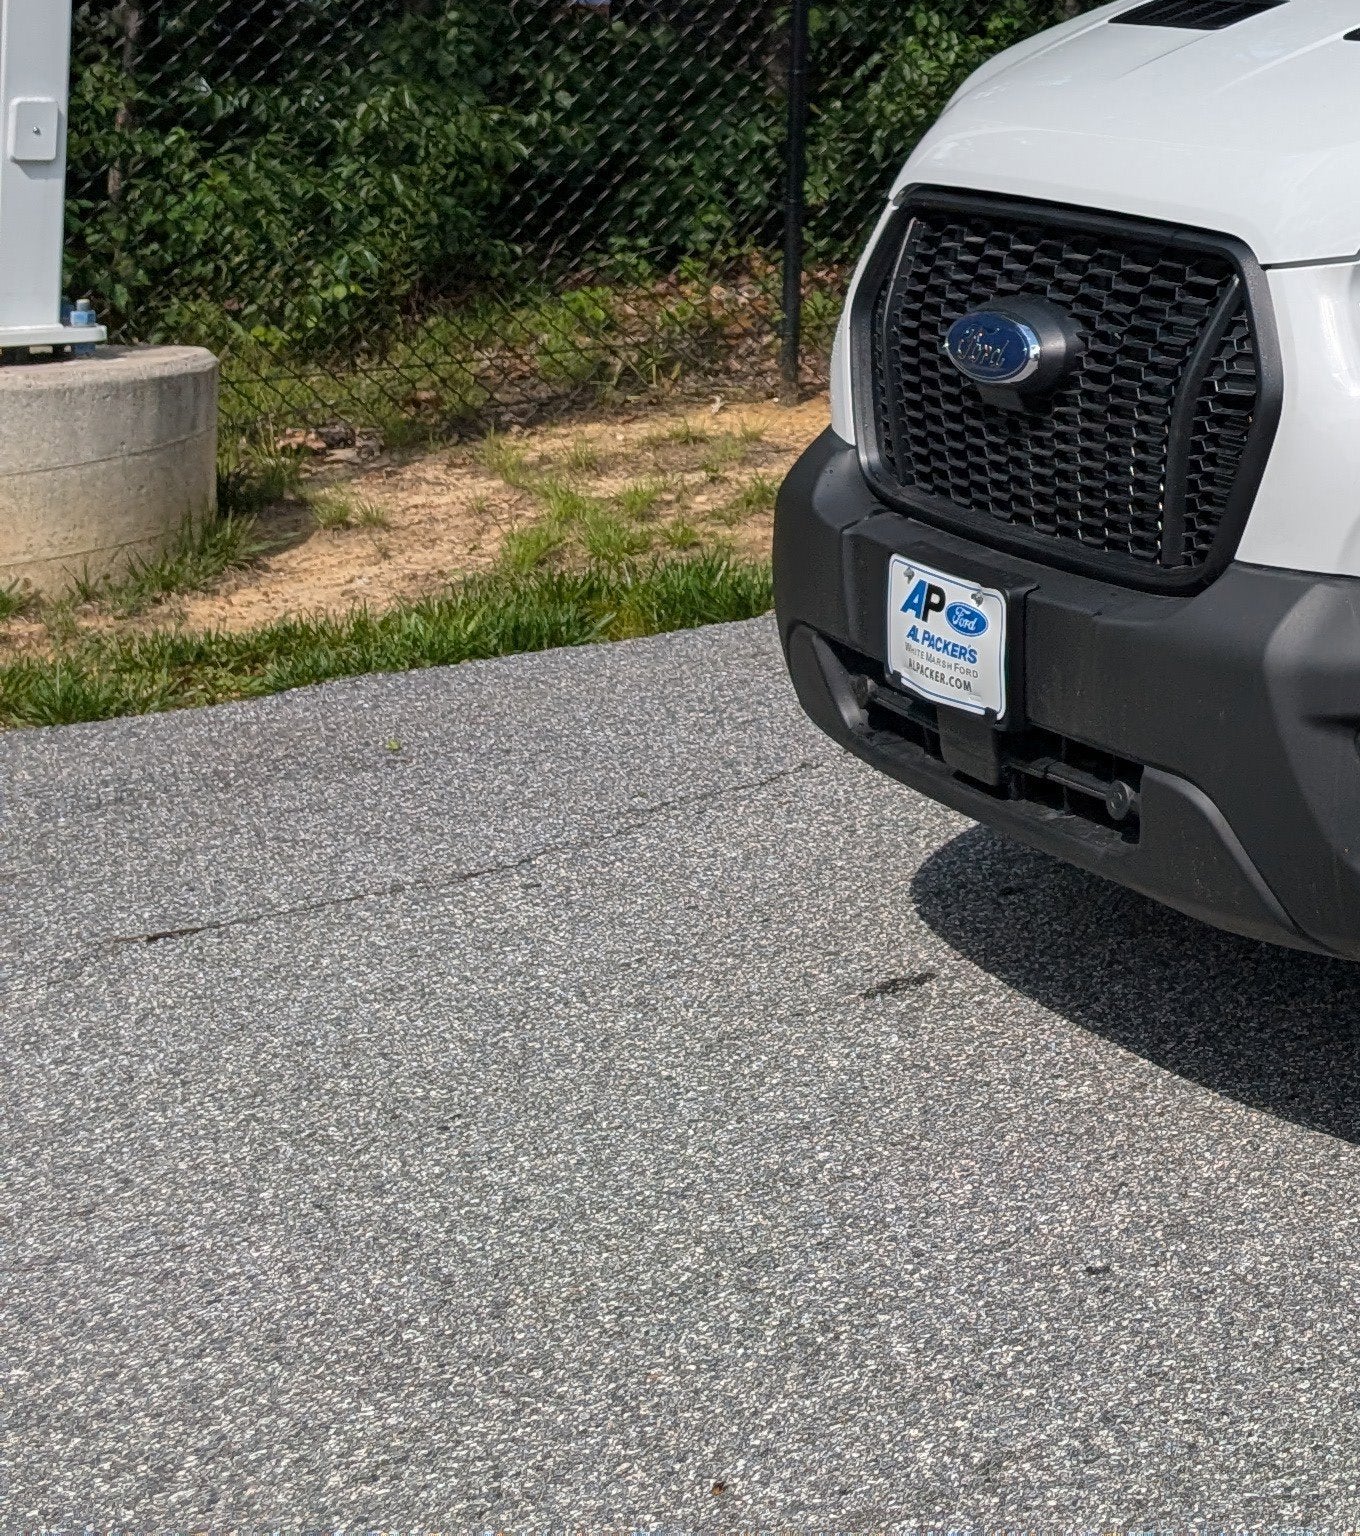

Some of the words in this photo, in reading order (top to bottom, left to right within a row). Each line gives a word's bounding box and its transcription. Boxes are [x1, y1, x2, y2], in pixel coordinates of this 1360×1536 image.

[901, 579, 946, 623] AP
[952, 606, 978, 631] Ford
[906, 625, 920, 643] AL
[921, 629, 978, 664] PACKER'S
[908, 658, 972, 692] ALPACKER.COM
[954, 663, 979, 679] FORD
